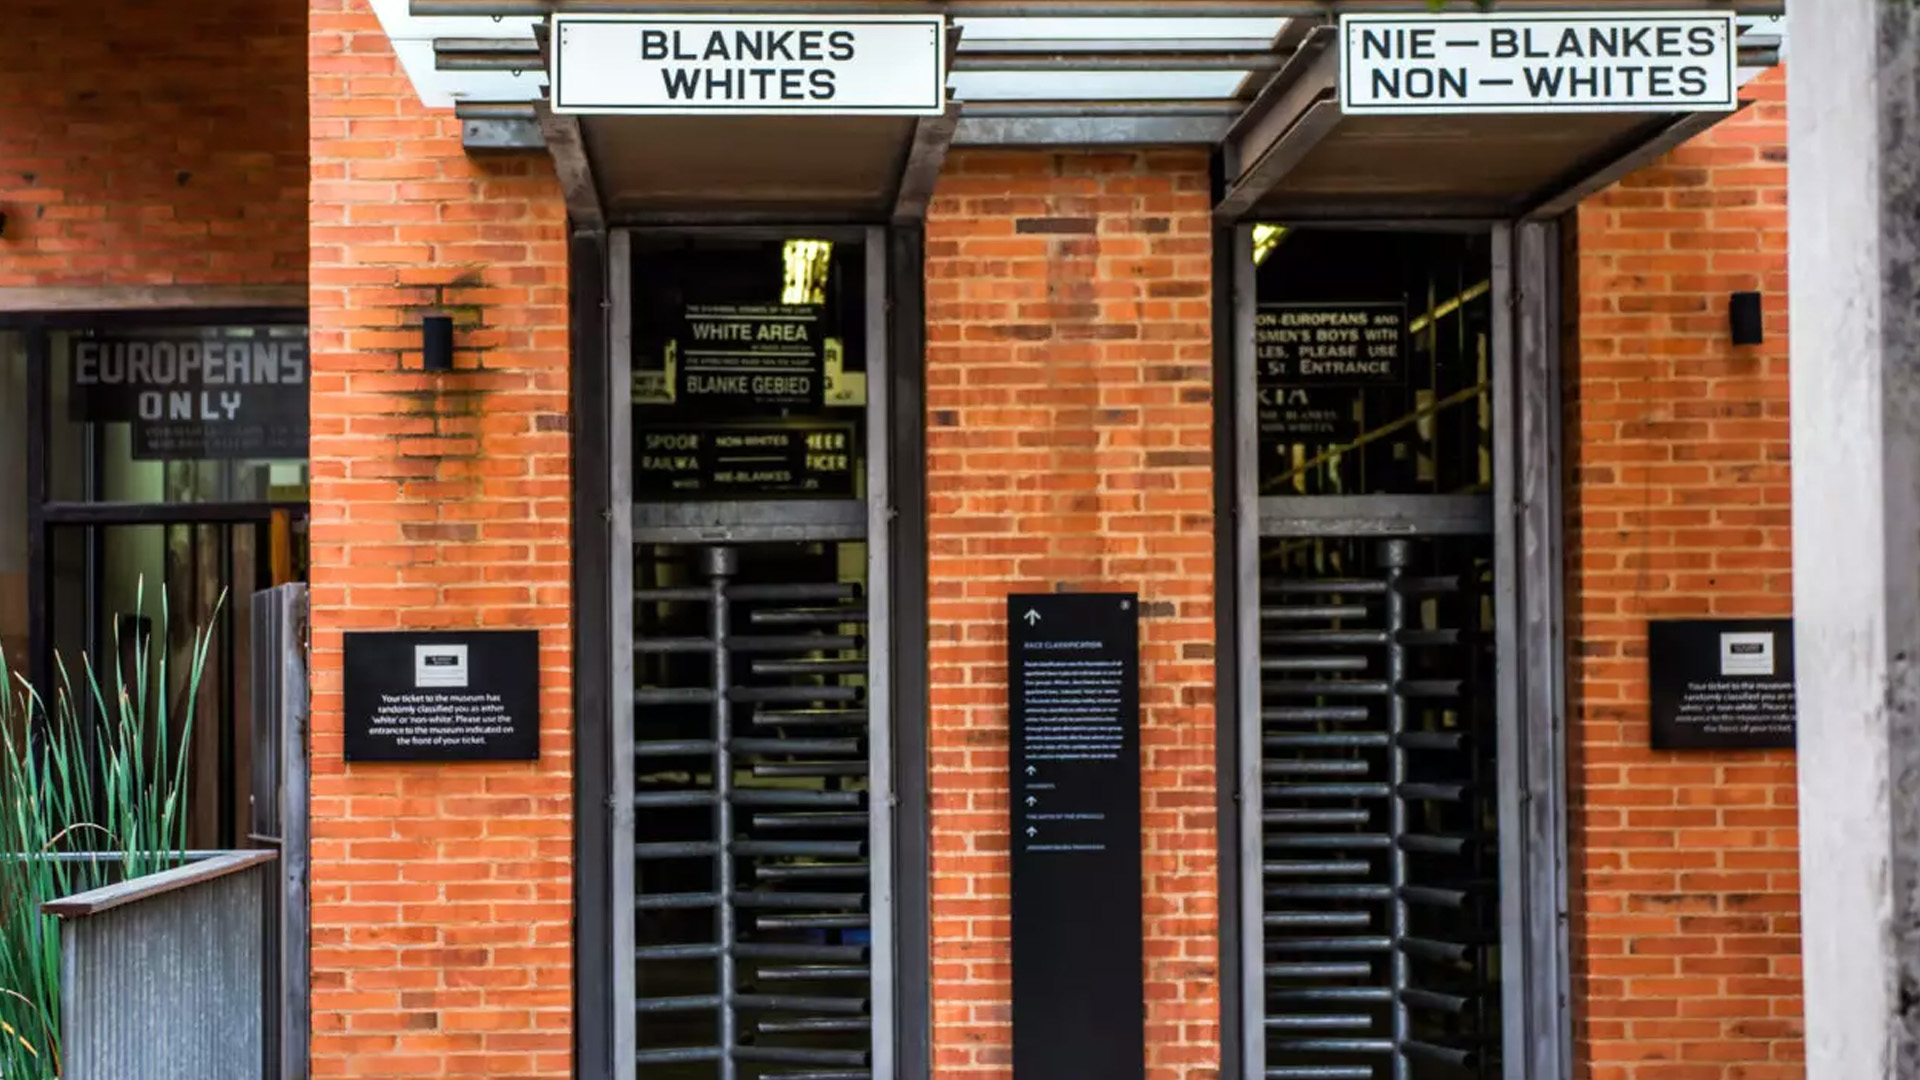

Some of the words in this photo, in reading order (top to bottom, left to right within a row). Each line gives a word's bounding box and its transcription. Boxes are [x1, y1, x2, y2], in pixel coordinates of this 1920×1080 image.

[641, 29, 856, 61] BLANKES
[660, 68, 837, 100] WHITES
[692, 322, 753, 341] WHITE
[756, 323, 809, 342] AREA
[1257, 327, 1312, 343] SMEN'S
[1315, 327, 1360, 342] BOYS
[1363, 326, 1399, 341] WITH
[1297, 344, 1358, 359] PLEASE
[1367, 344, 1398, 359] USE
[76, 341, 304, 384] EUROPEANS
[1299, 359, 1391, 375] ENTRANCE
[686, 375, 750, 395] BLANKE
[752, 374, 811, 395] GEBIED
[138, 391, 241, 420] ONLY
[645, 432, 699, 450] SPOOR
[641, 455, 701, 471] RAILWA
[804, 452, 849, 471] FICER
[382, 694, 400, 703] Your
[401, 694, 425, 703] ticket
[425, 694, 434, 703] to
[434, 694, 449, 703] the
[450, 694, 485, 703] museum
[486, 694, 501, 703] has
[377, 705, 416, 715] randomly
[417, 704, 454, 713] classified
[454, 705, 470, 714] you
[481, 704, 505, 713] either
[398, 716, 408, 724] or
[455, 715, 481, 724] Please
[497, 715, 512, 724] the
[369, 726, 404, 735] entrance
[405, 726, 414, 735] to
[414, 726, 429, 735] the
[429, 726, 465, 735] museum
[465, 726, 502, 735] indicated
[502, 726, 514, 735] on
[396, 736, 411, 745] the
[411, 736, 432, 745] front
[432, 736, 443, 745] of
[442, 737, 461, 746] your
